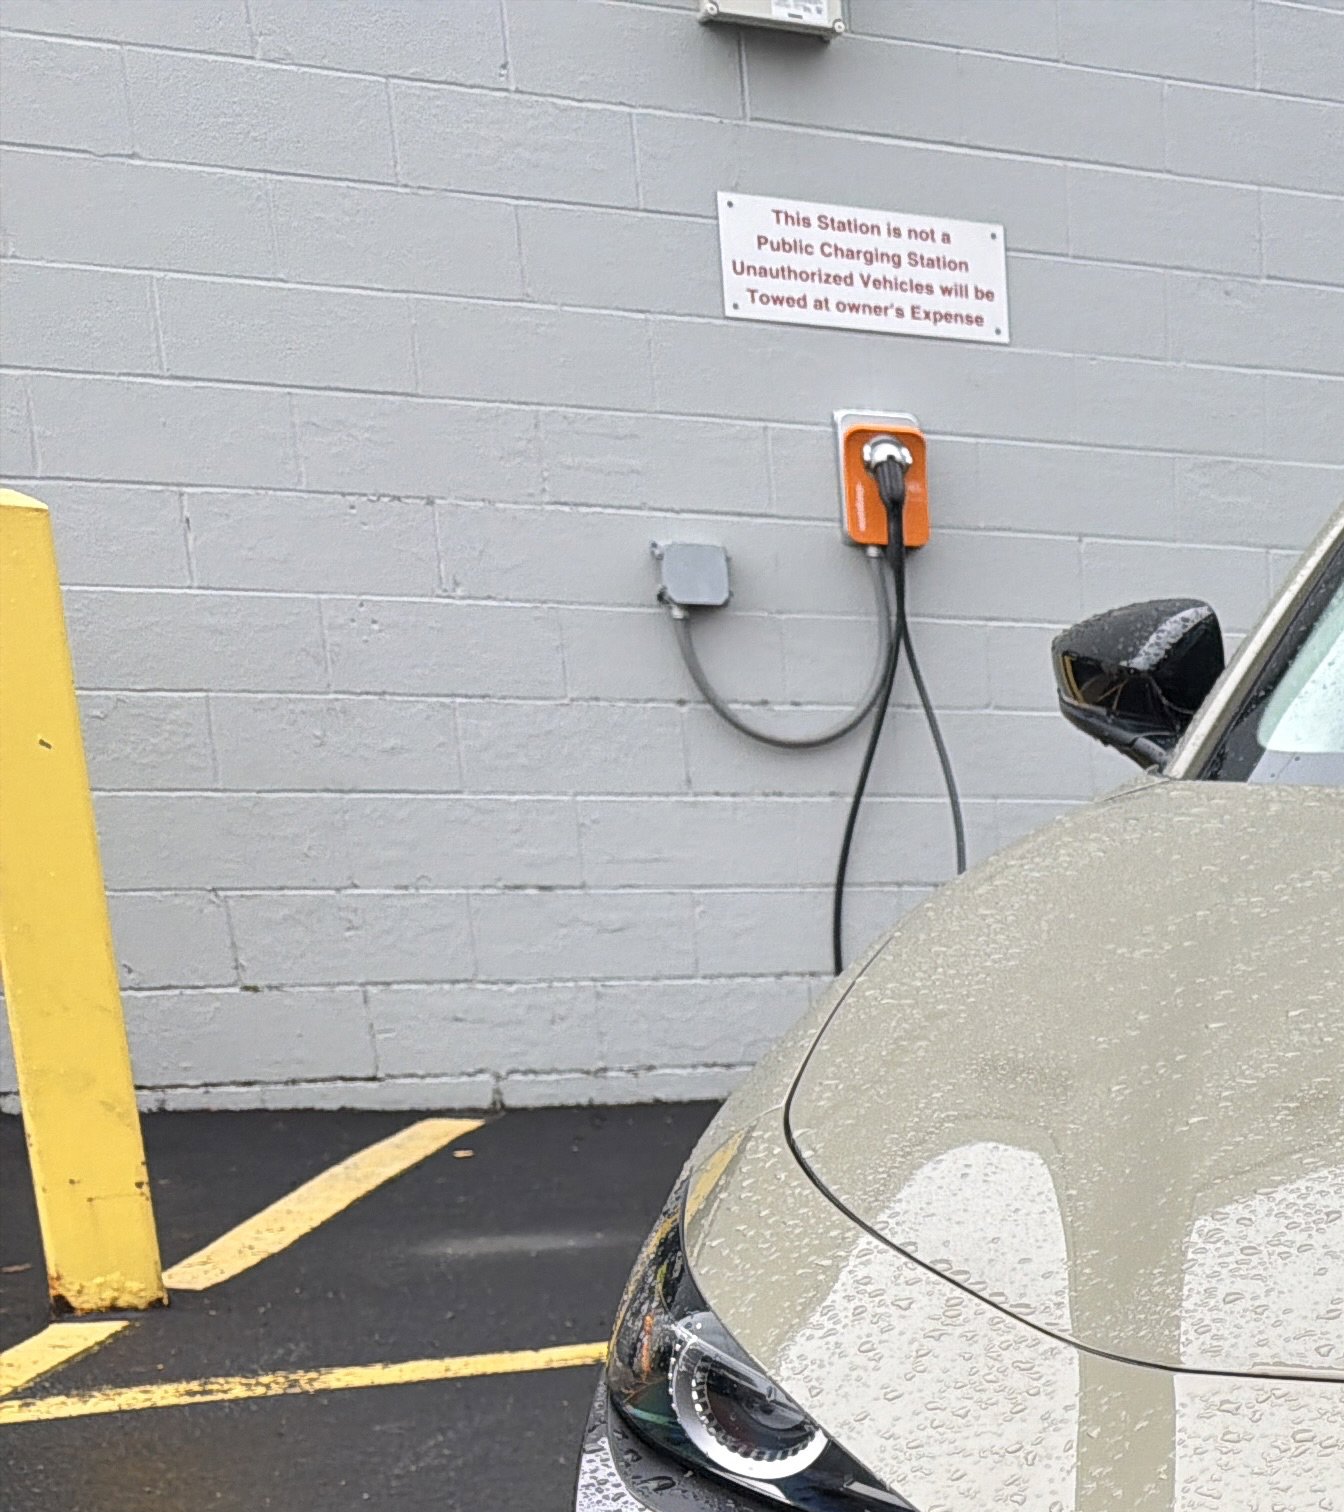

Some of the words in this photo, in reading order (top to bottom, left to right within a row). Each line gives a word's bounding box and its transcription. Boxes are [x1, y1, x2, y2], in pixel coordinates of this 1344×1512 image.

[771, 208, 812, 228] This
[817, 214, 881, 237] Station
[886, 221, 902, 239] is
[907, 227, 936, 243] not
[941, 231, 951, 245] a
[757, 234, 815, 256] Public
[820, 241, 902, 269] Charging
[907, 251, 969, 273] Station
[732, 259, 854, 287] Unauthorized
[859, 272, 934, 296] Vehicles
[940, 282, 969, 300] will
[974, 284, 995, 302] be
[746, 287, 808, 309] Towed
[813, 296, 830, 312] at
[835, 300, 905, 319] owner's
[910, 304, 985, 327] Expense
